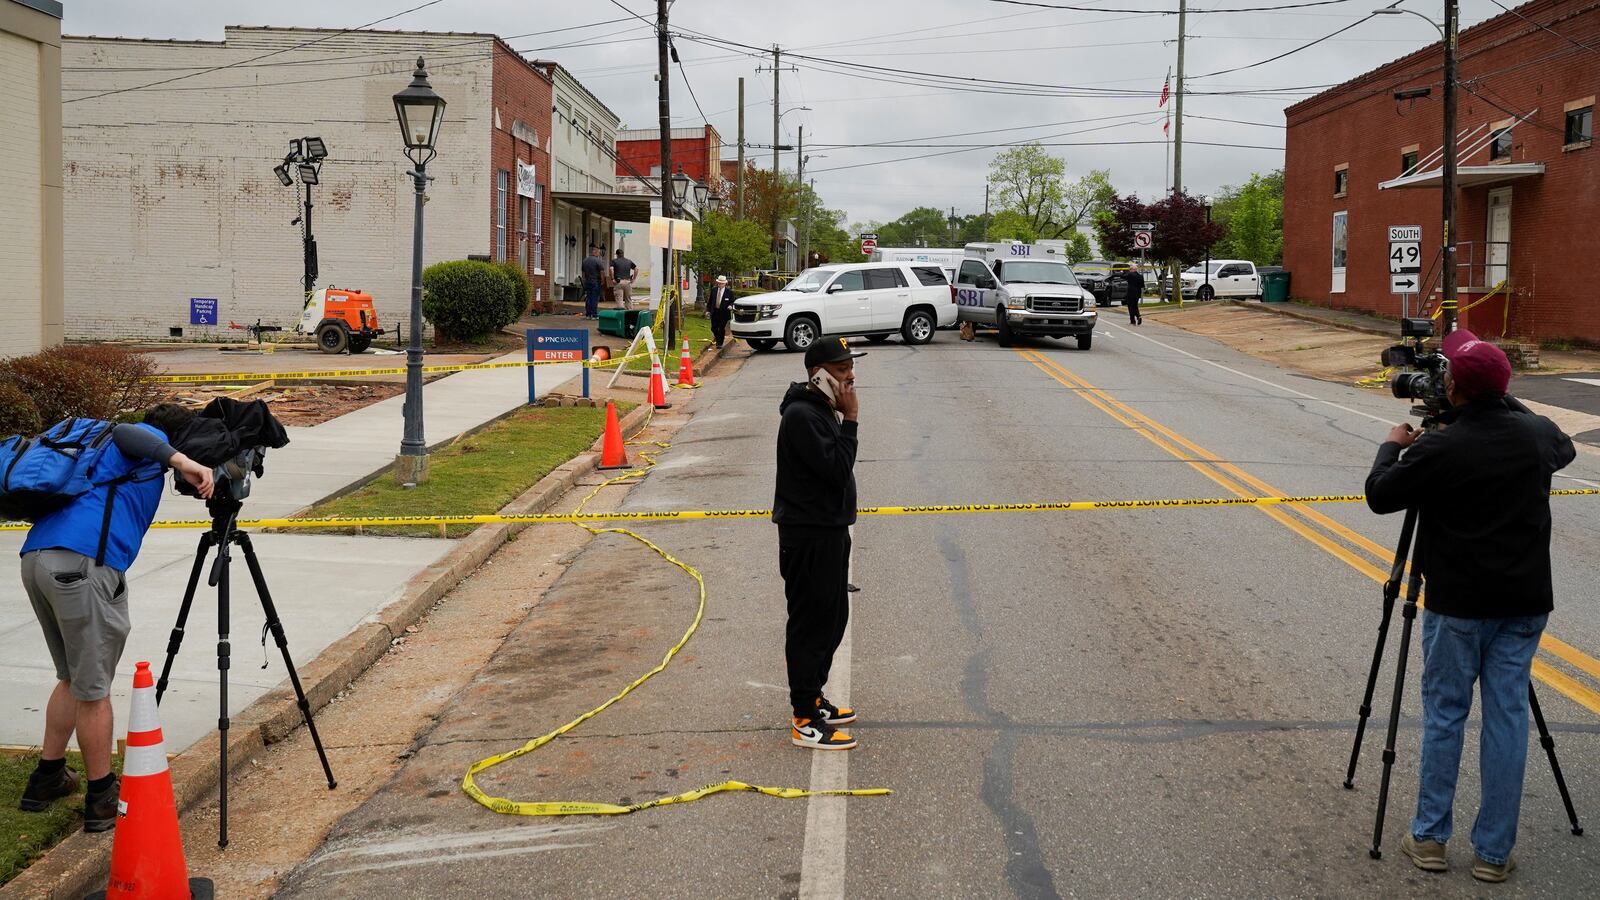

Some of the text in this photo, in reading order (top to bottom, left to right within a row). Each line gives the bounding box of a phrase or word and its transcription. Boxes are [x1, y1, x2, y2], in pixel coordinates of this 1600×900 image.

[1391, 229, 1419, 239] SOUTH
[1010, 244, 1031, 256] SBI
[1391, 247, 1419, 263] 49
[958, 289, 985, 307] SBI
[839, 337, 848, 350] P
[545, 351, 574, 359] ENTER
